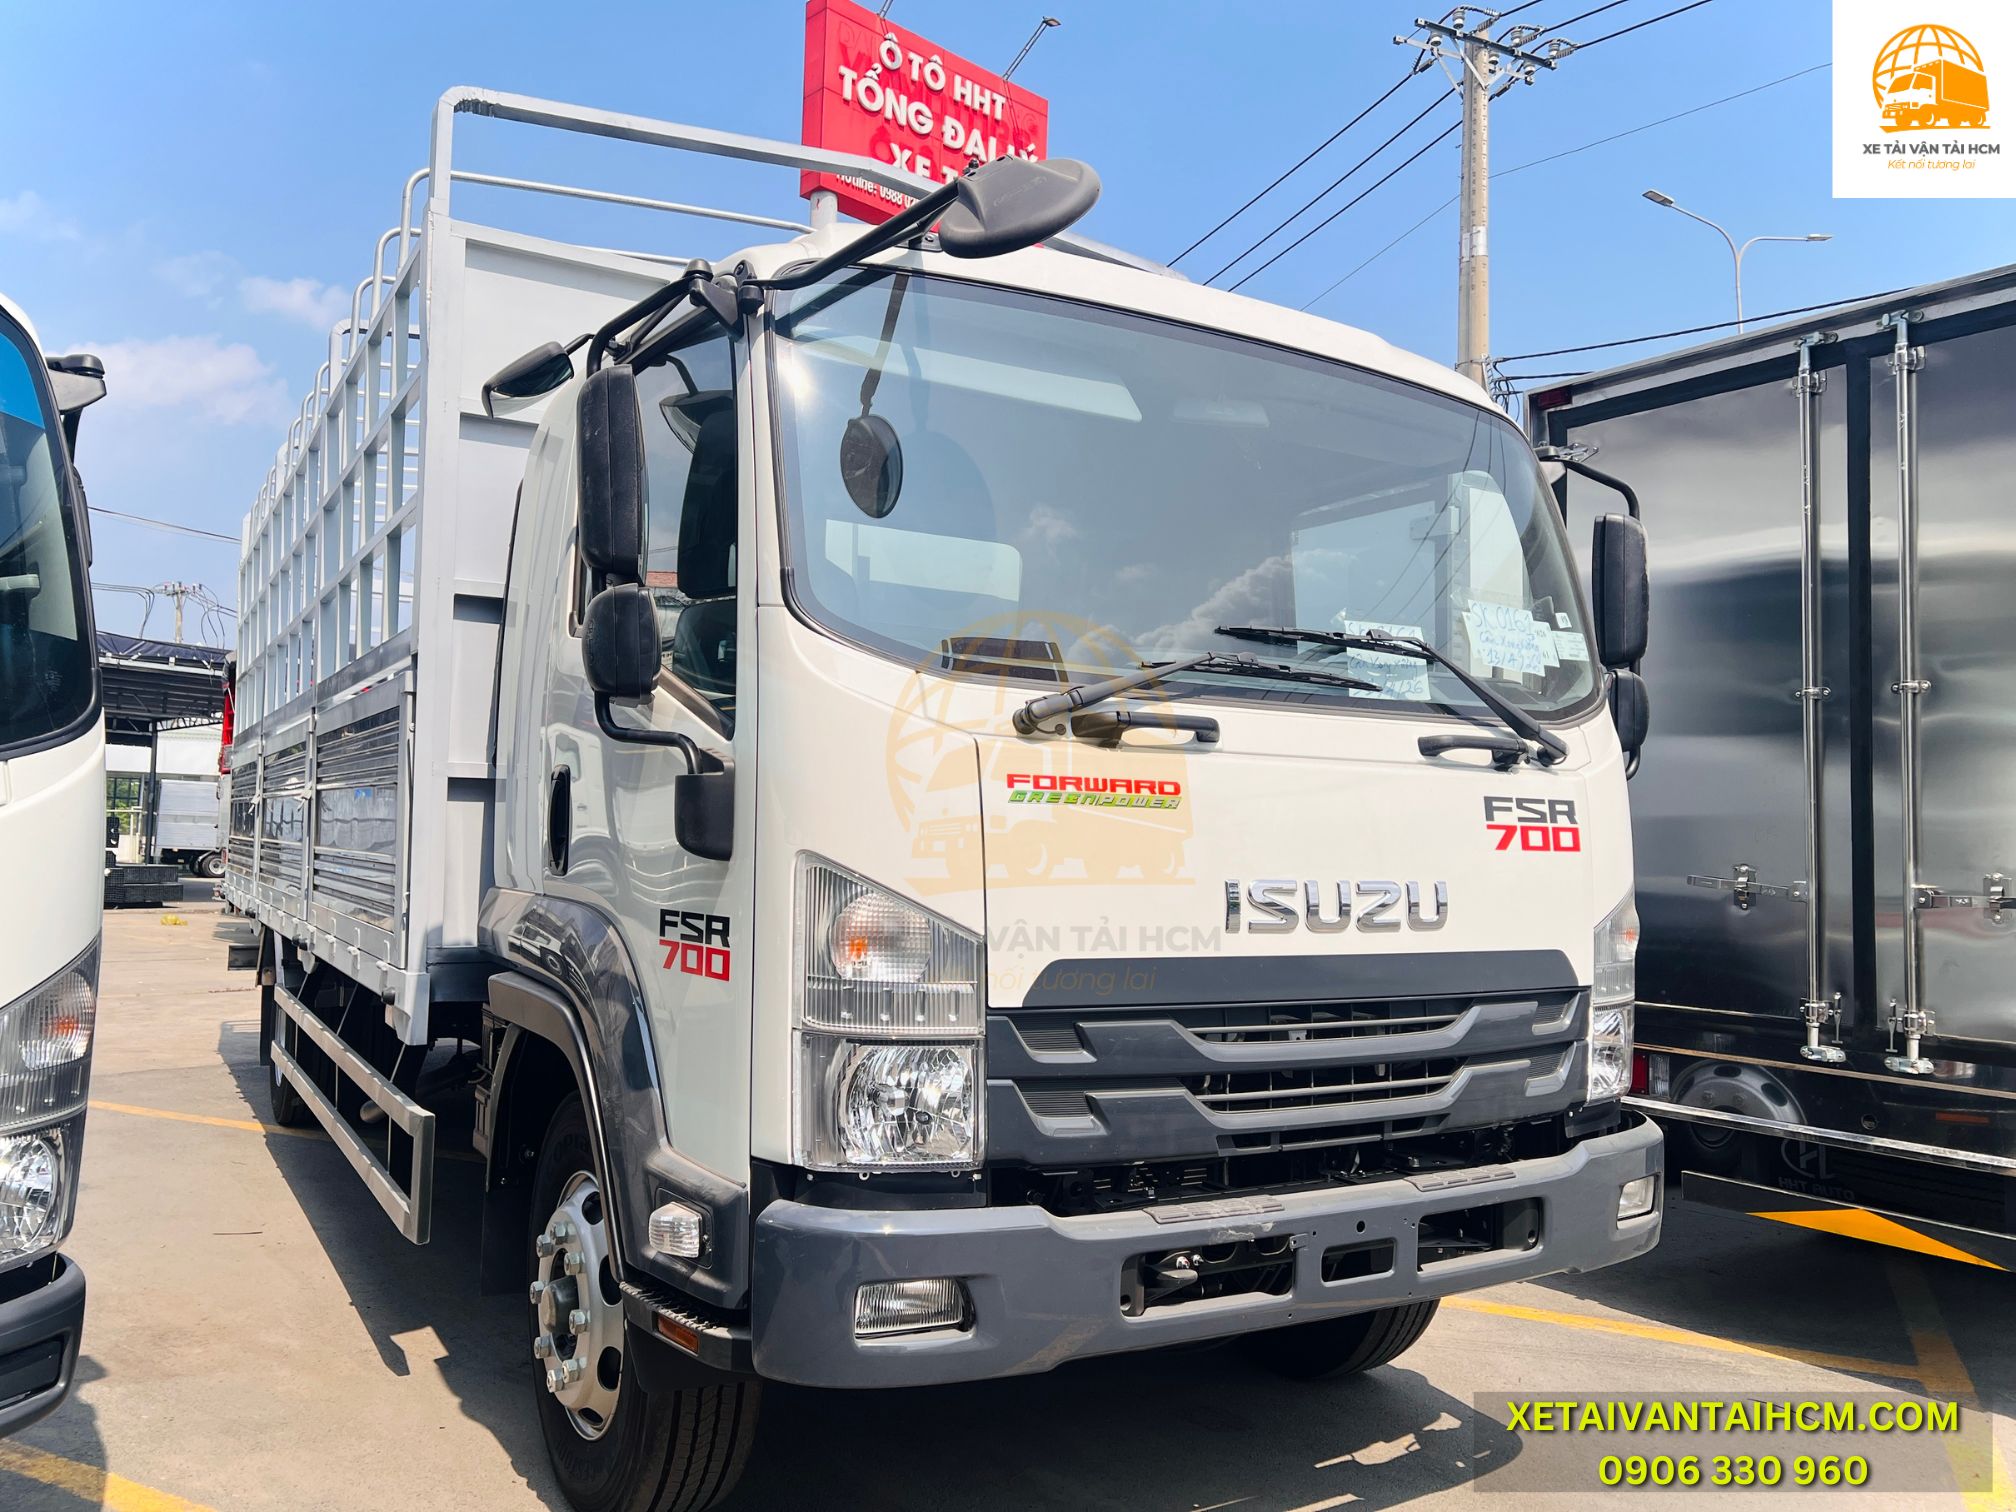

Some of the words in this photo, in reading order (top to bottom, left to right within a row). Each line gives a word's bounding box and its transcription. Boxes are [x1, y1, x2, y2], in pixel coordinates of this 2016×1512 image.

[879, 32, 903, 71] Ô
[908, 54, 946, 92] TÔ
[953, 74, 1006, 121] HHT
[838, 62, 934, 135] TỔNG
[1006, 773, 1181, 796] FORWARD
[1007, 789, 1182, 810] GREENPOWER
[1483, 795, 1579, 825] FSR
[1485, 824, 1581, 852] 700
[1224, 878, 1448, 934] ISUZU
[659, 908, 731, 948] FSR
[658, 938, 731, 982] 700
